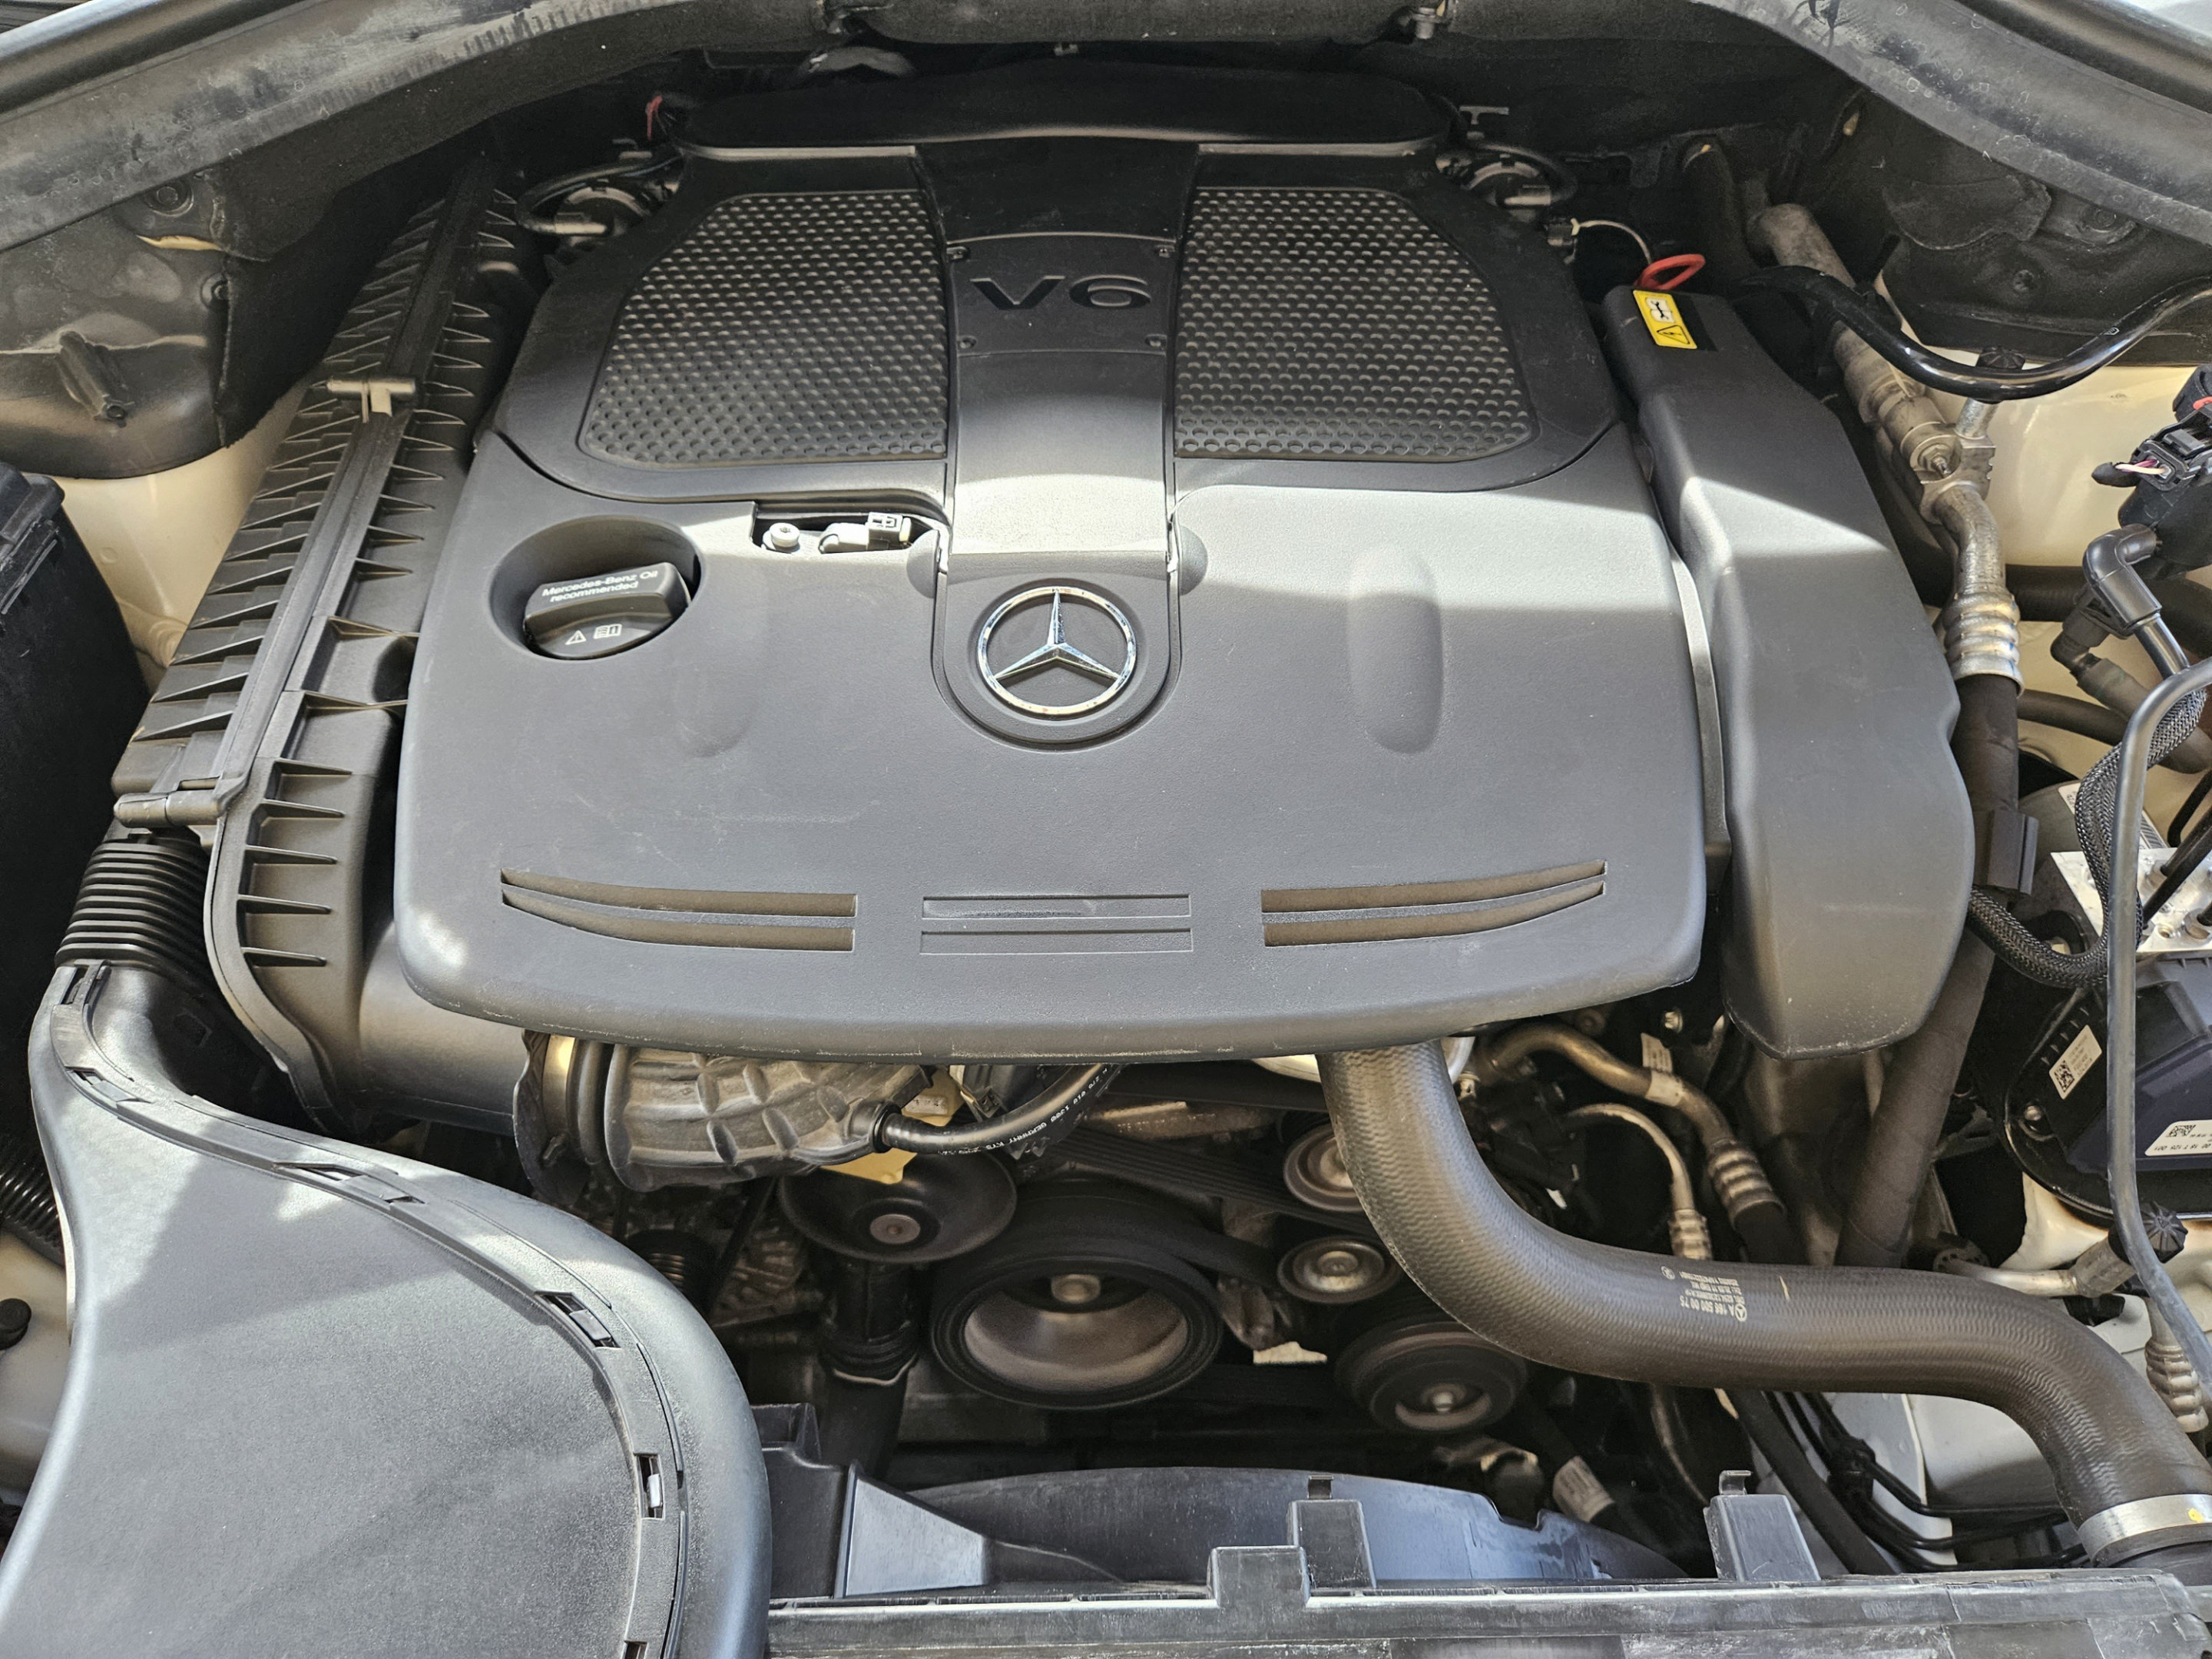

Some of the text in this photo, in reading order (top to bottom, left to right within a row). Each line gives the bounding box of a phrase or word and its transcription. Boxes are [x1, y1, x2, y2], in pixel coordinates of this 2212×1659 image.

[969, 274, 1151, 309] V6
[541, 570, 658, 597] Mercedes-Benz Oil
[550, 581, 639, 602] recommended
[1008, 1121, 1048, 1144] GERMANY
